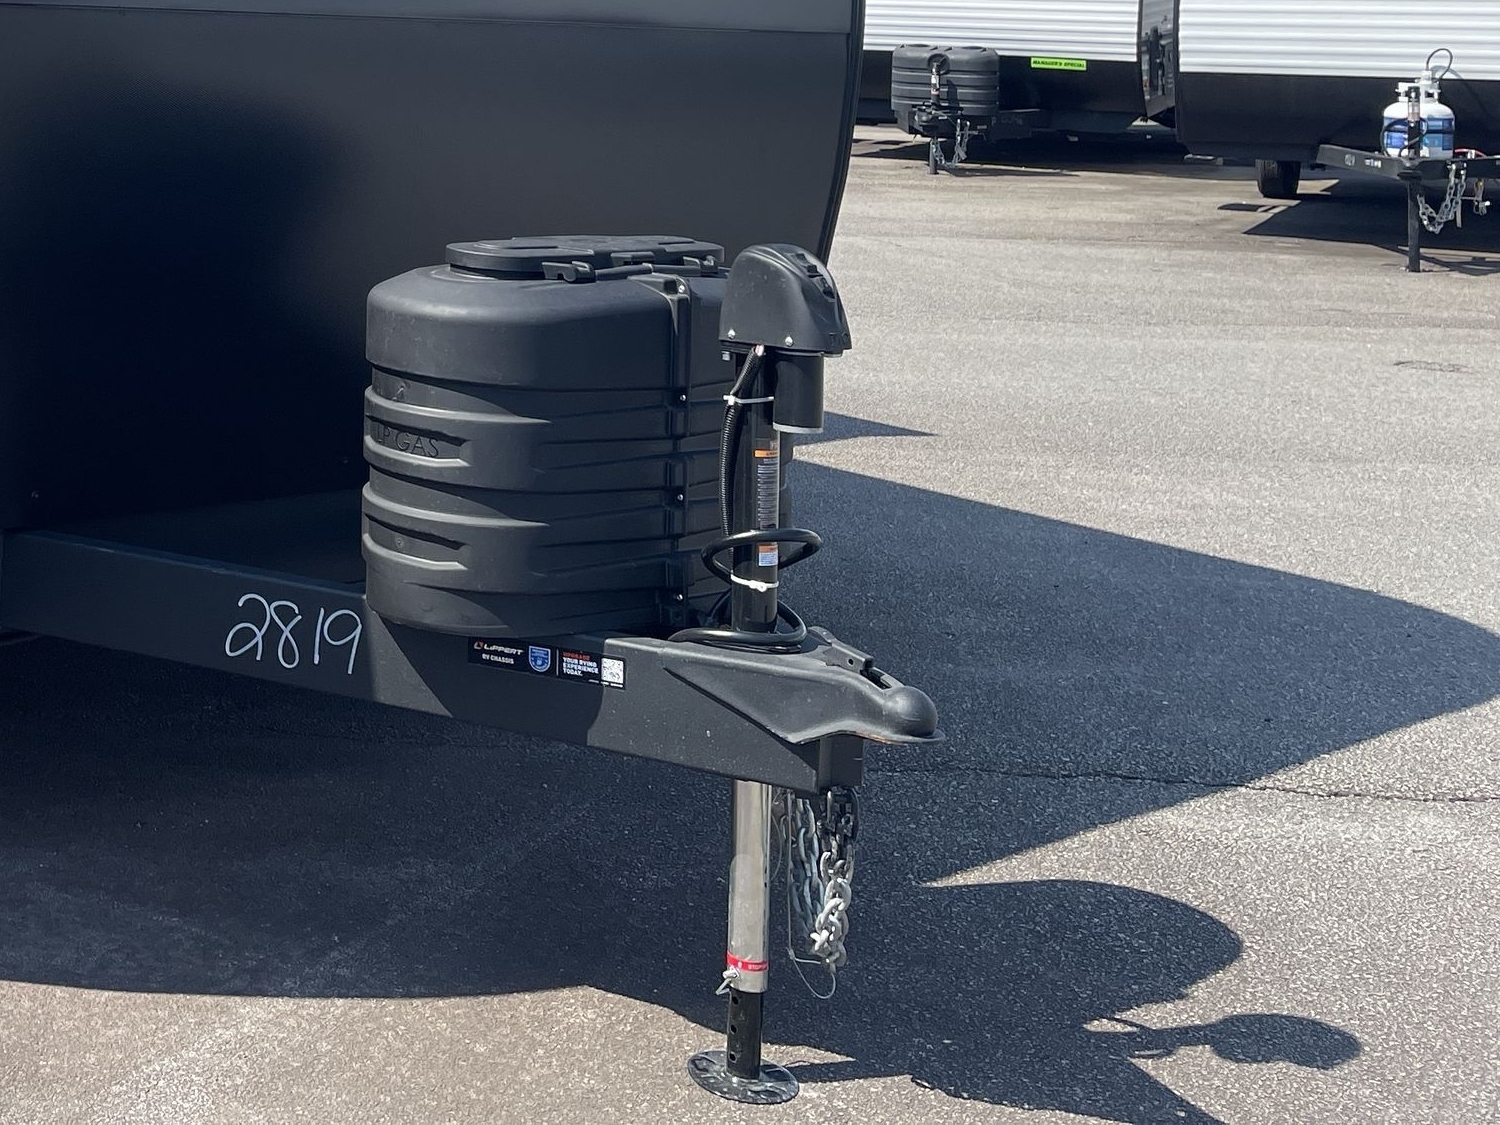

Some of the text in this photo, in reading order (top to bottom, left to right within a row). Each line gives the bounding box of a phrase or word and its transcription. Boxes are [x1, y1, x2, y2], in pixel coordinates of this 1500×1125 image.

[396, 431, 438, 458] GAS
[225, 593, 362, 675] 2819
[484, 643, 524, 656] LIPPERT
[490, 654, 514, 665] CHASSIS
[563, 657, 578, 665] YOUR
[563, 662, 599, 674] EXPERIENCE
